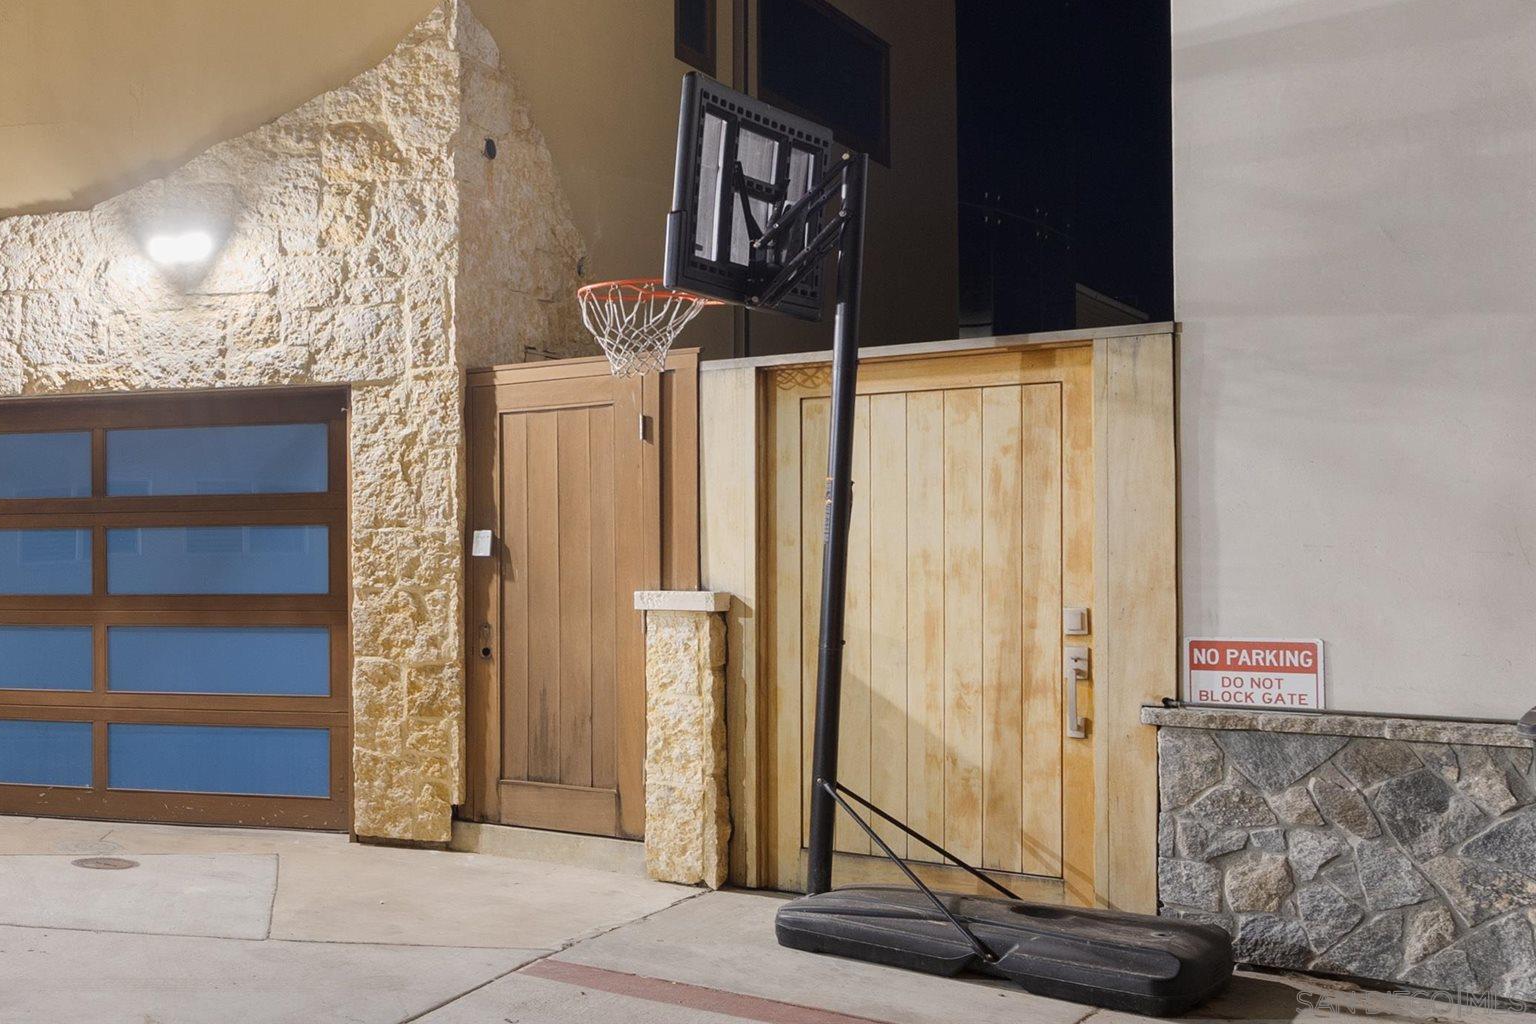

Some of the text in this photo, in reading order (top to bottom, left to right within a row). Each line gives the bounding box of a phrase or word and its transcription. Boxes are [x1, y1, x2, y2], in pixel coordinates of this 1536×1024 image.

[1193, 648, 1313, 668] NO PARKING
[1221, 676, 1284, 690] DO NOT
[1199, 690, 1309, 706] BLOCK GATE
